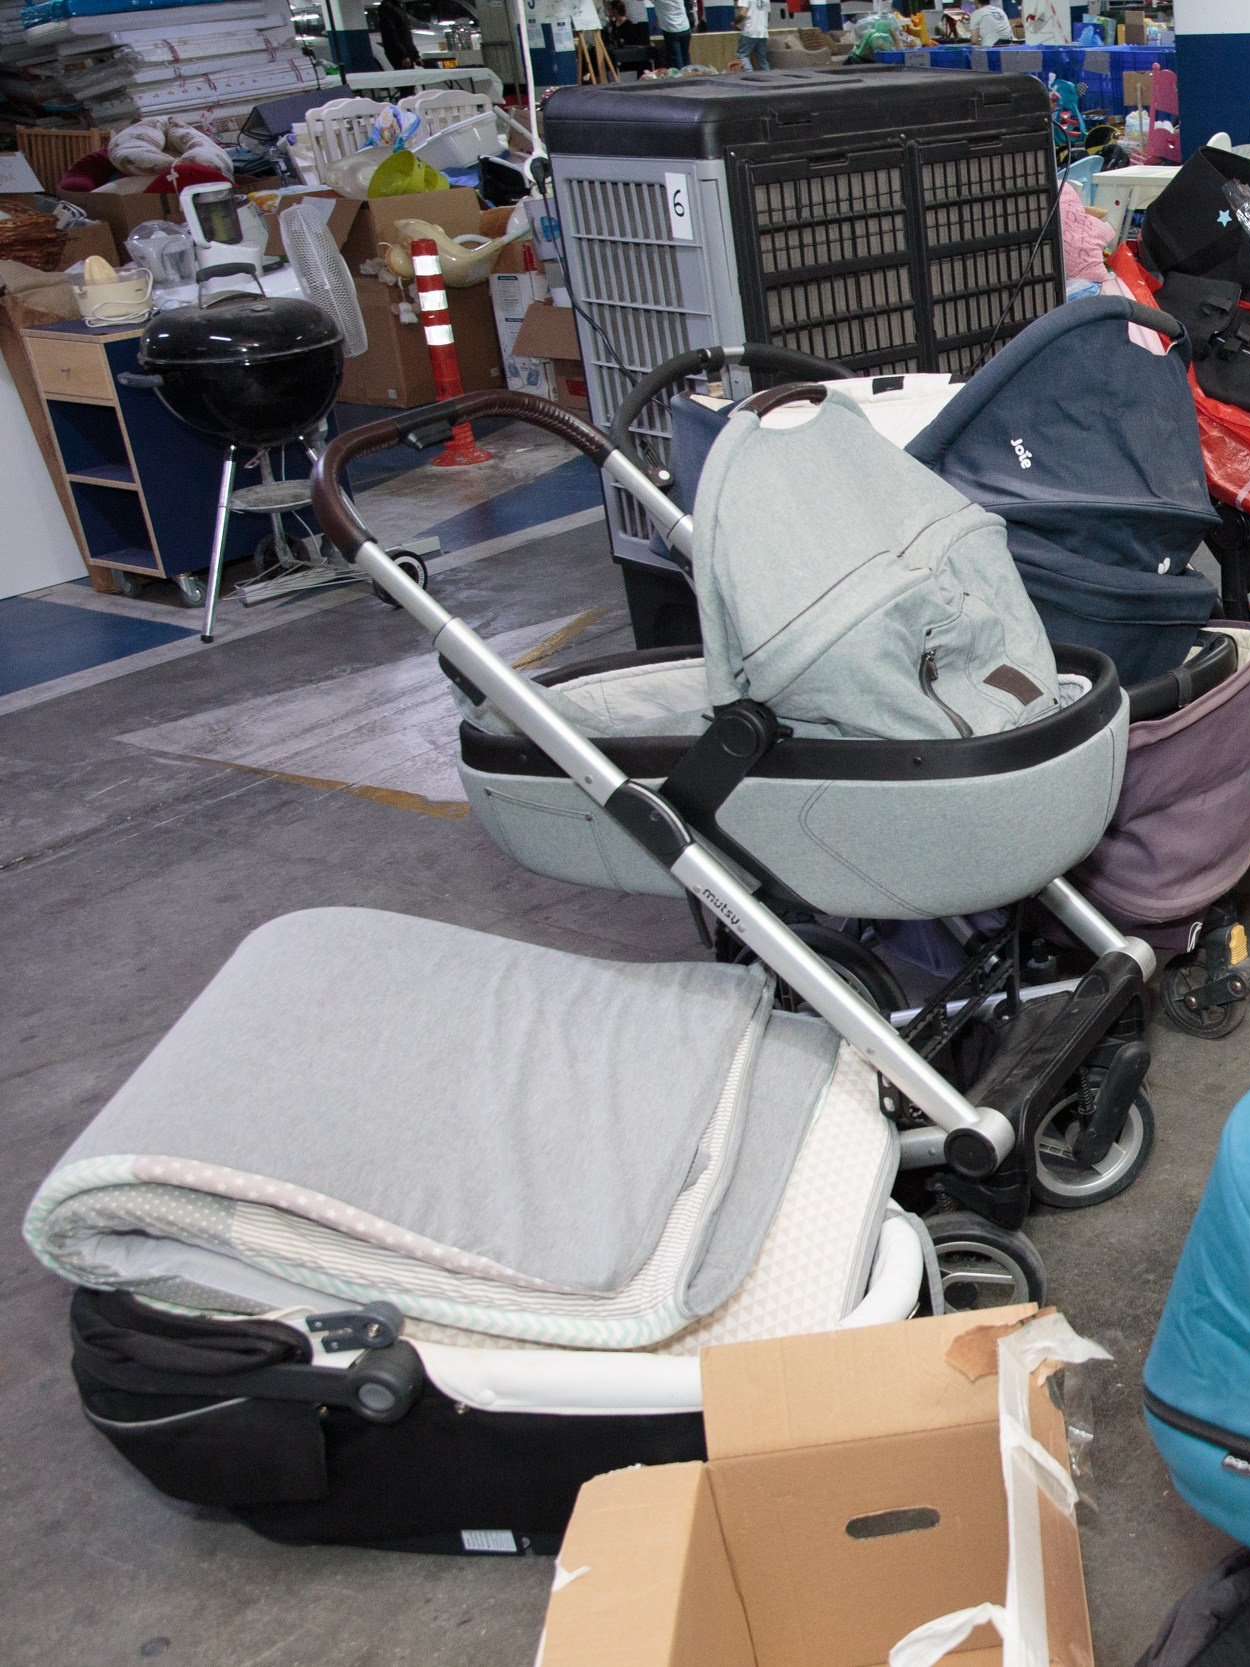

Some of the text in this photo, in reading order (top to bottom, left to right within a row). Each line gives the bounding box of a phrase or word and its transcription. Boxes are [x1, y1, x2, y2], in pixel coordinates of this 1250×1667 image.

[673, 189, 685, 217] 6
[1010, 438, 1032, 469] Joie
[702, 888, 741, 925] mutsy
